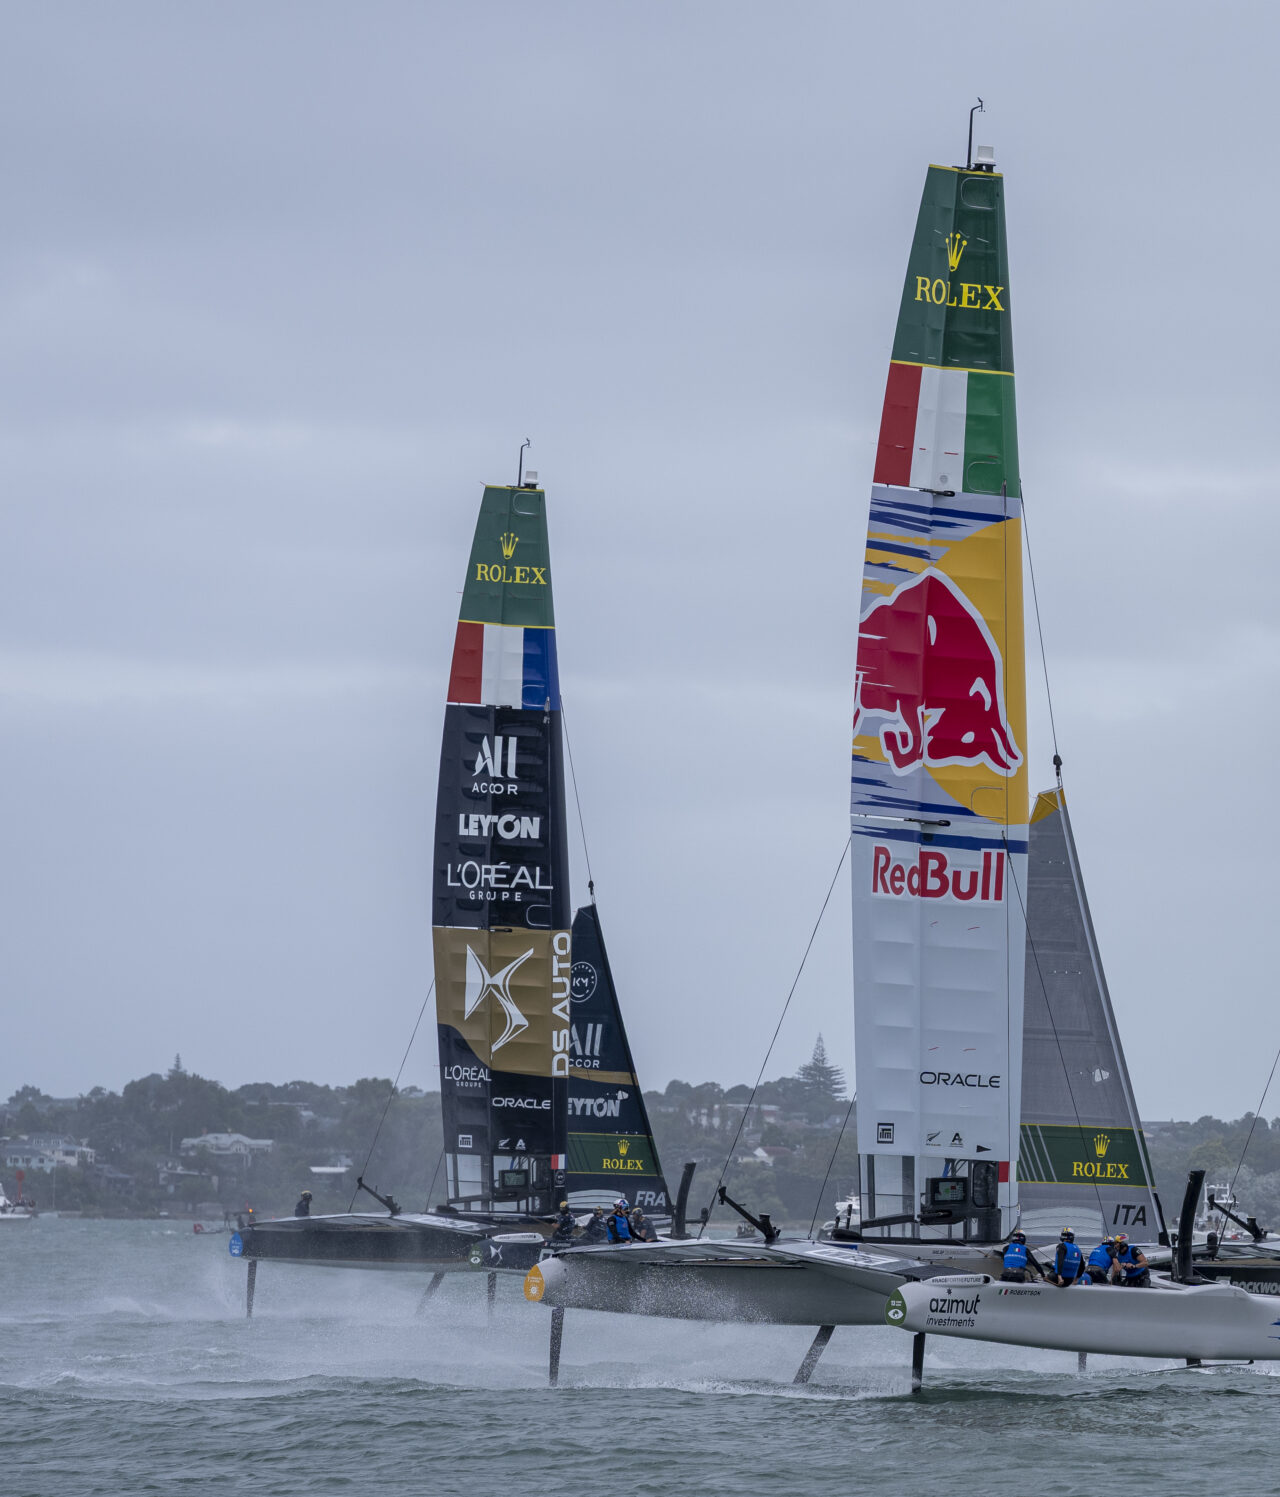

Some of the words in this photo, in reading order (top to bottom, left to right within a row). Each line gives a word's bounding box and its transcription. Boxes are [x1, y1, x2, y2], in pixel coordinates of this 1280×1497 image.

[914, 275, 1005, 312] ROLEX
[475, 563, 547, 585] ROLEX
[471, 782, 518, 795] ACCOR
[458, 814, 540, 839] LEYTON
[552, 932, 571, 1022] AUTO
[552, 1028, 570, 1077] DS
[920, 1071, 1001, 1088] ORACLE
[492, 1097, 551, 1110] ORACLE
[568, 1097, 621, 1118] EYTON
[602, 1158, 644, 1171] ROLEX
[1072, 1161, 1129, 1179] ROLEX
[634, 1190, 666, 1207] FRA
[1112, 1204, 1148, 1226] ITA
[929, 1293, 981, 1315] azimut
[926, 1314, 975, 1327] investments
